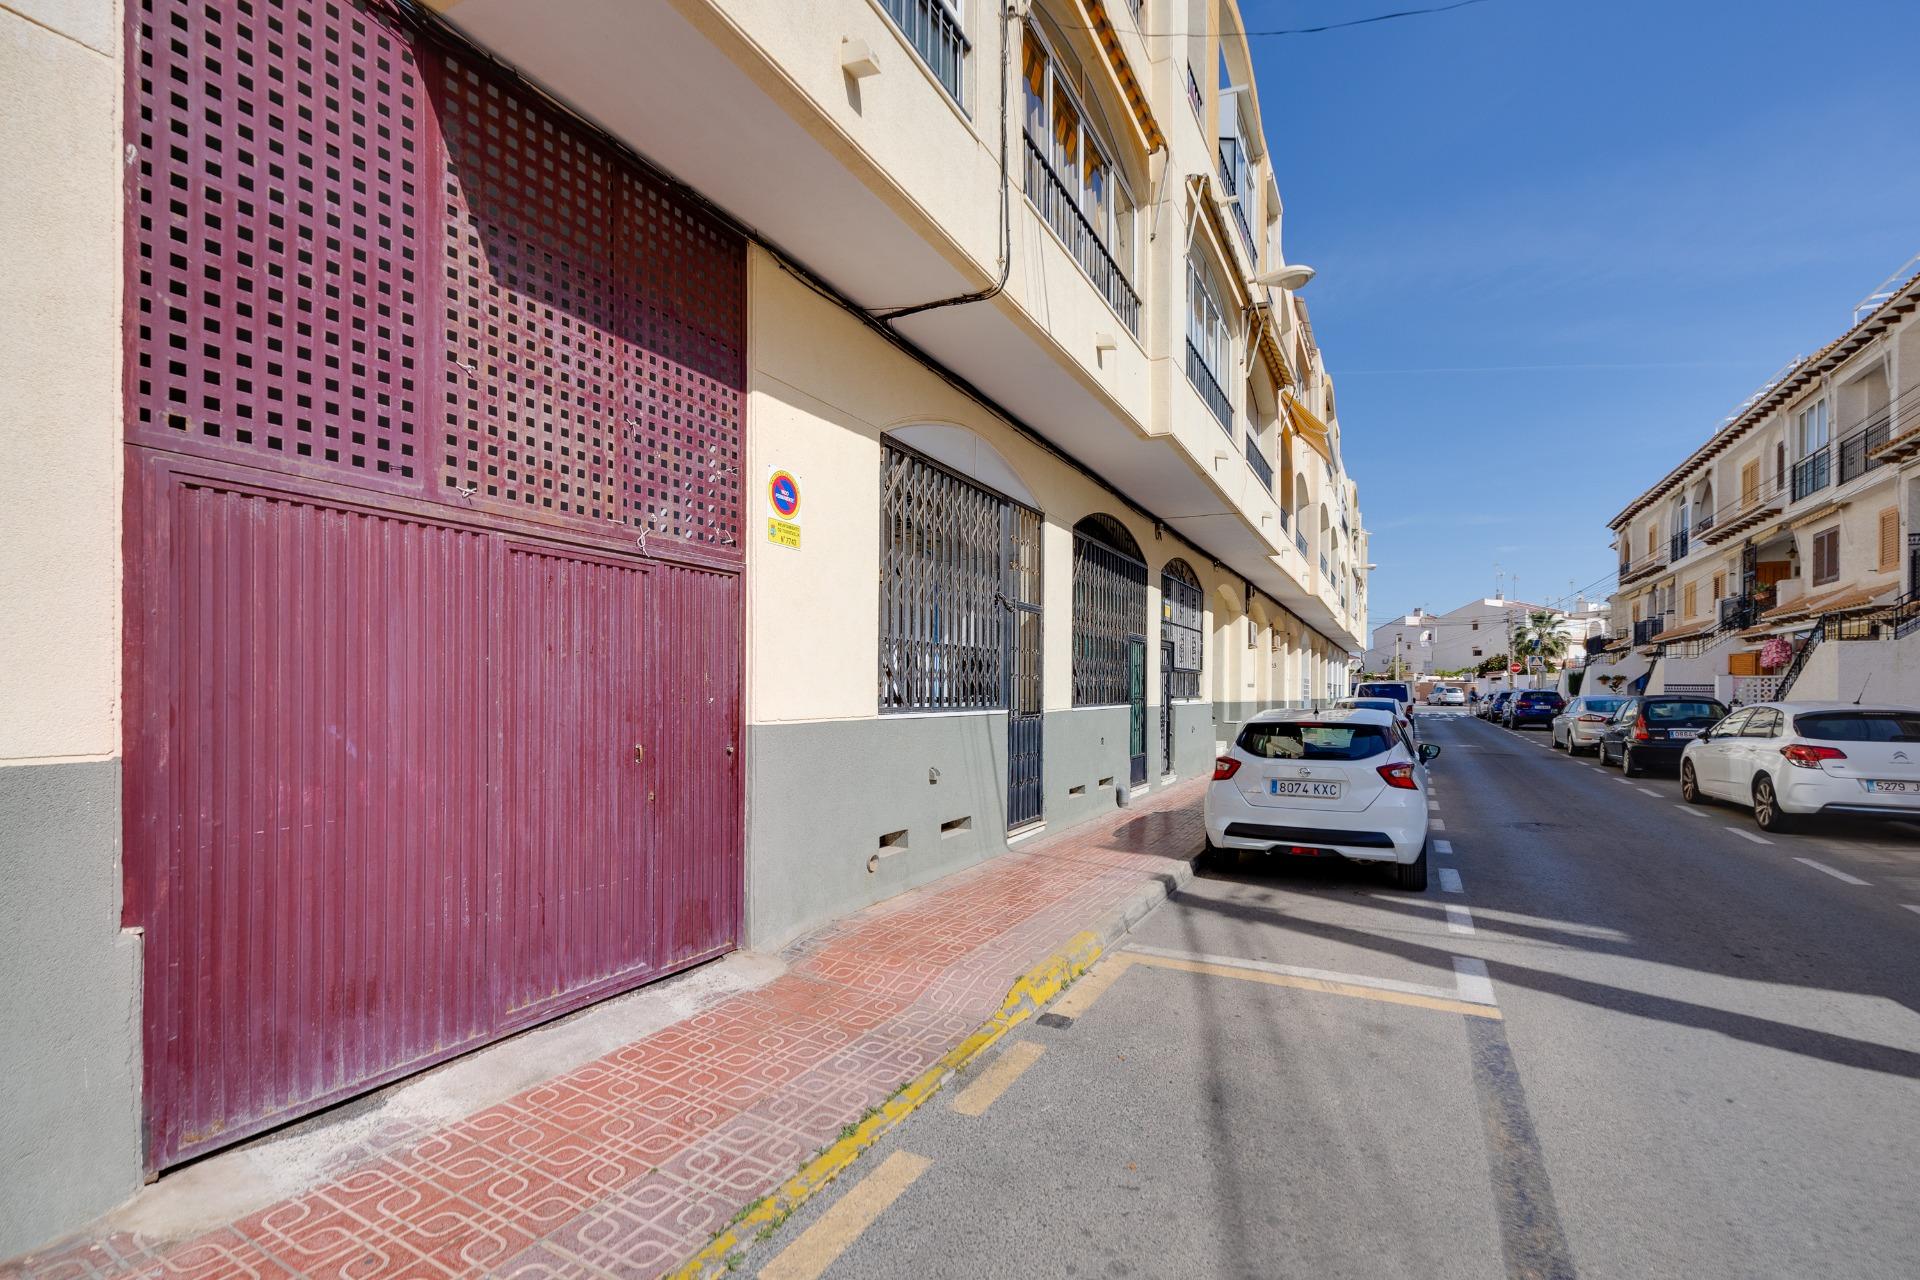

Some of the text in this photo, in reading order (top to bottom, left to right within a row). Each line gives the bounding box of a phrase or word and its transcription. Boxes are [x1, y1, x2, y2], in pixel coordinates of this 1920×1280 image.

[1280, 783, 1337, 796] 8074 KXC
[1876, 781, 1906, 791] 5279
